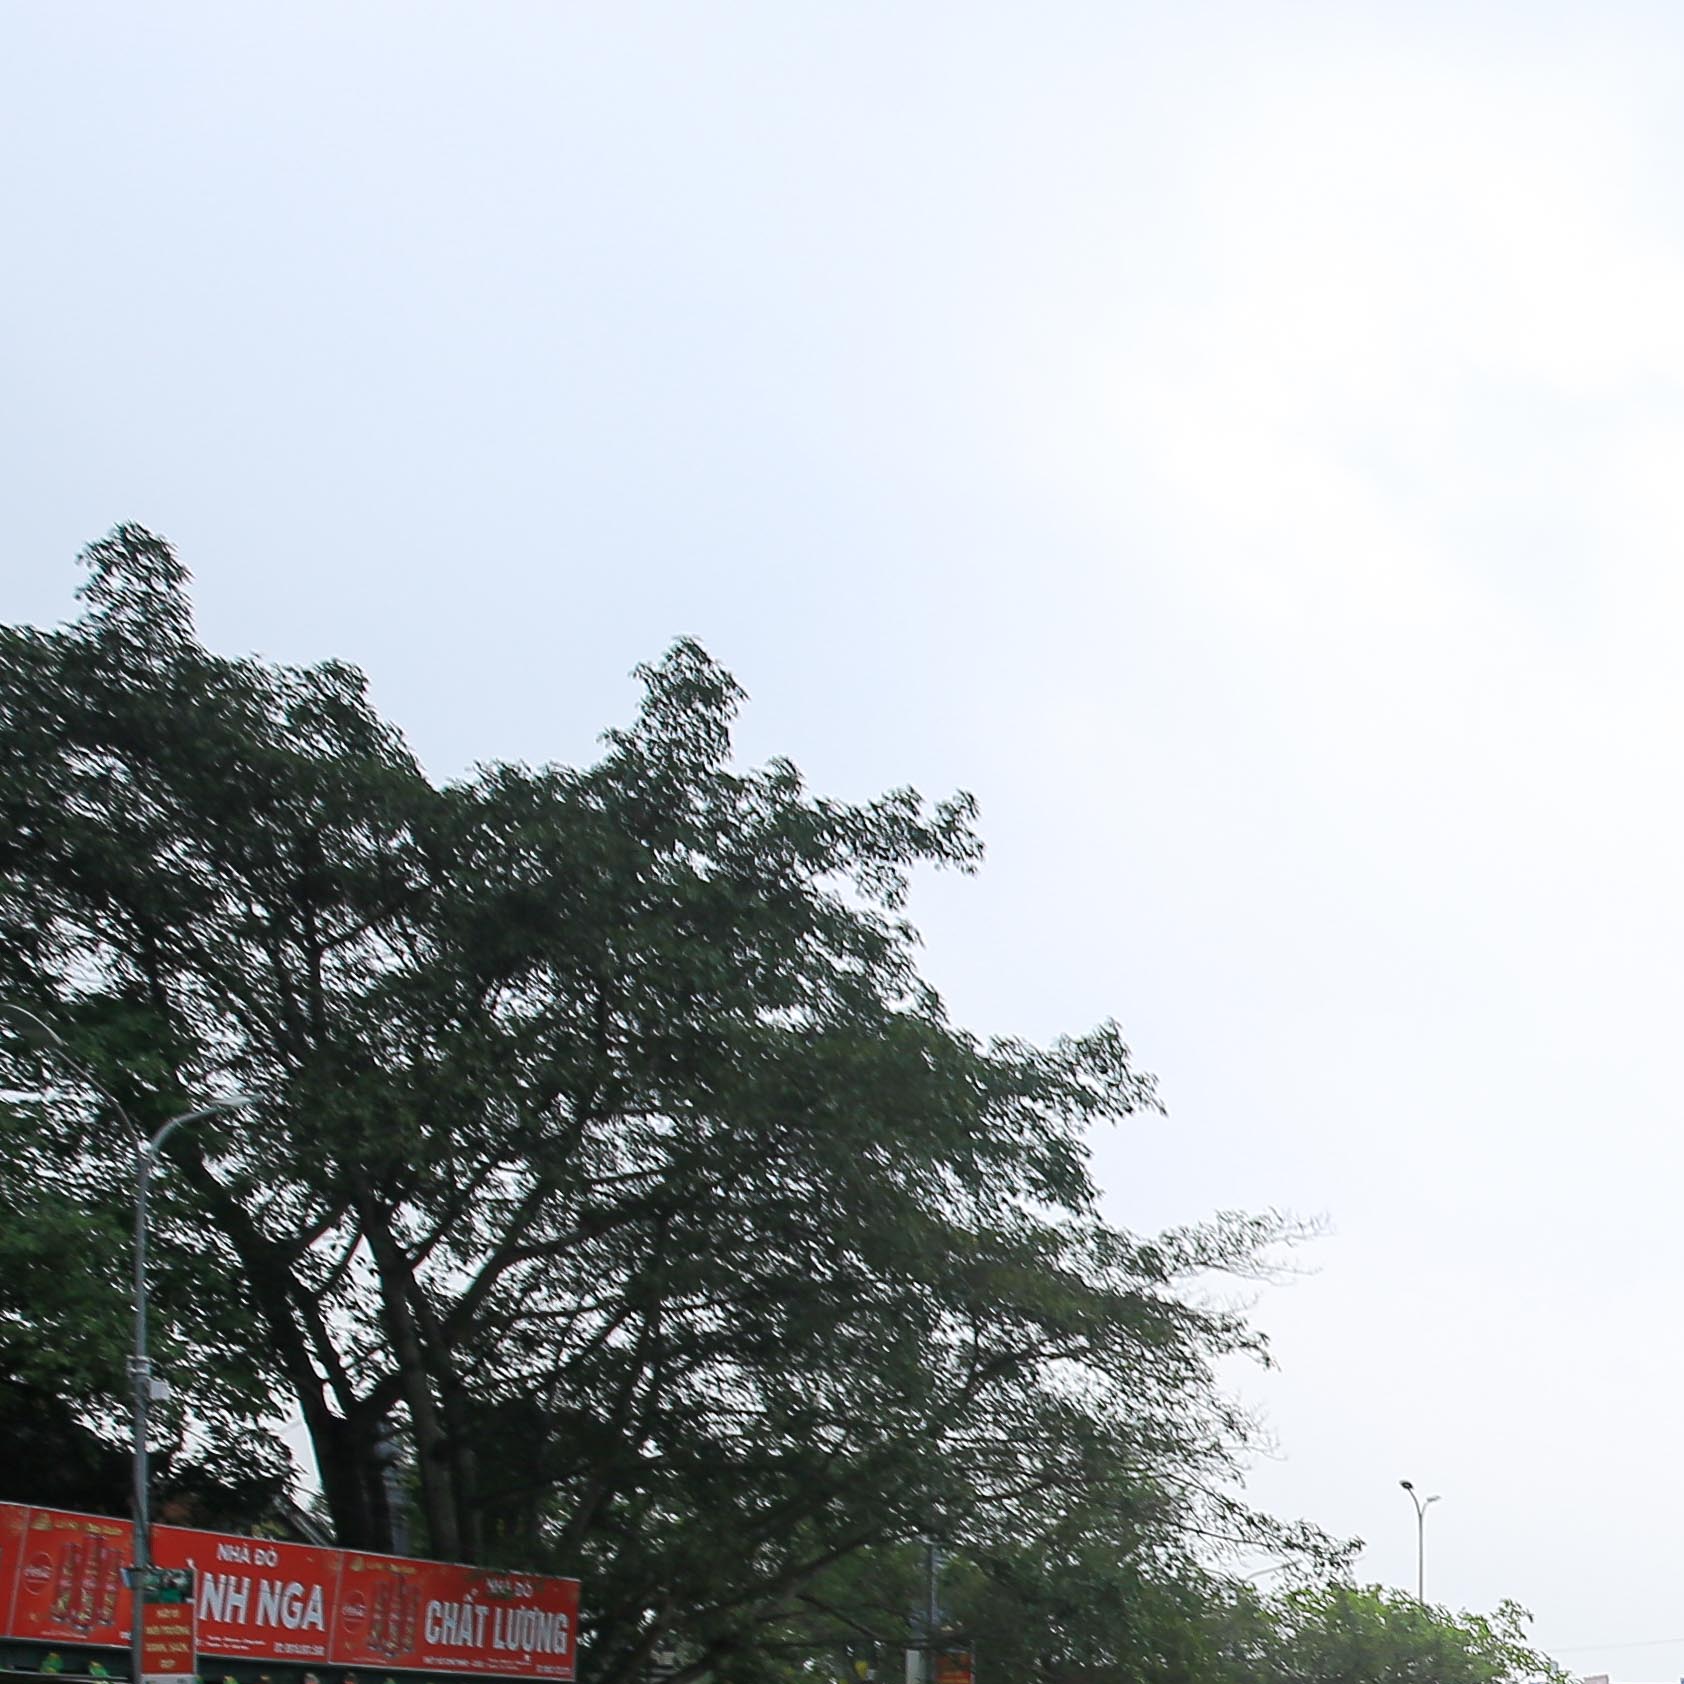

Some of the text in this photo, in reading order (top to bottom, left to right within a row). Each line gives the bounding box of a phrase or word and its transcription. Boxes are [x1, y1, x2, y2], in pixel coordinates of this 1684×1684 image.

[216, 1542, 252, 1565] NHÀ
[255, 1577, 326, 1632] NGA
[424, 1588, 570, 1664] CHẤT LƯỢNG
